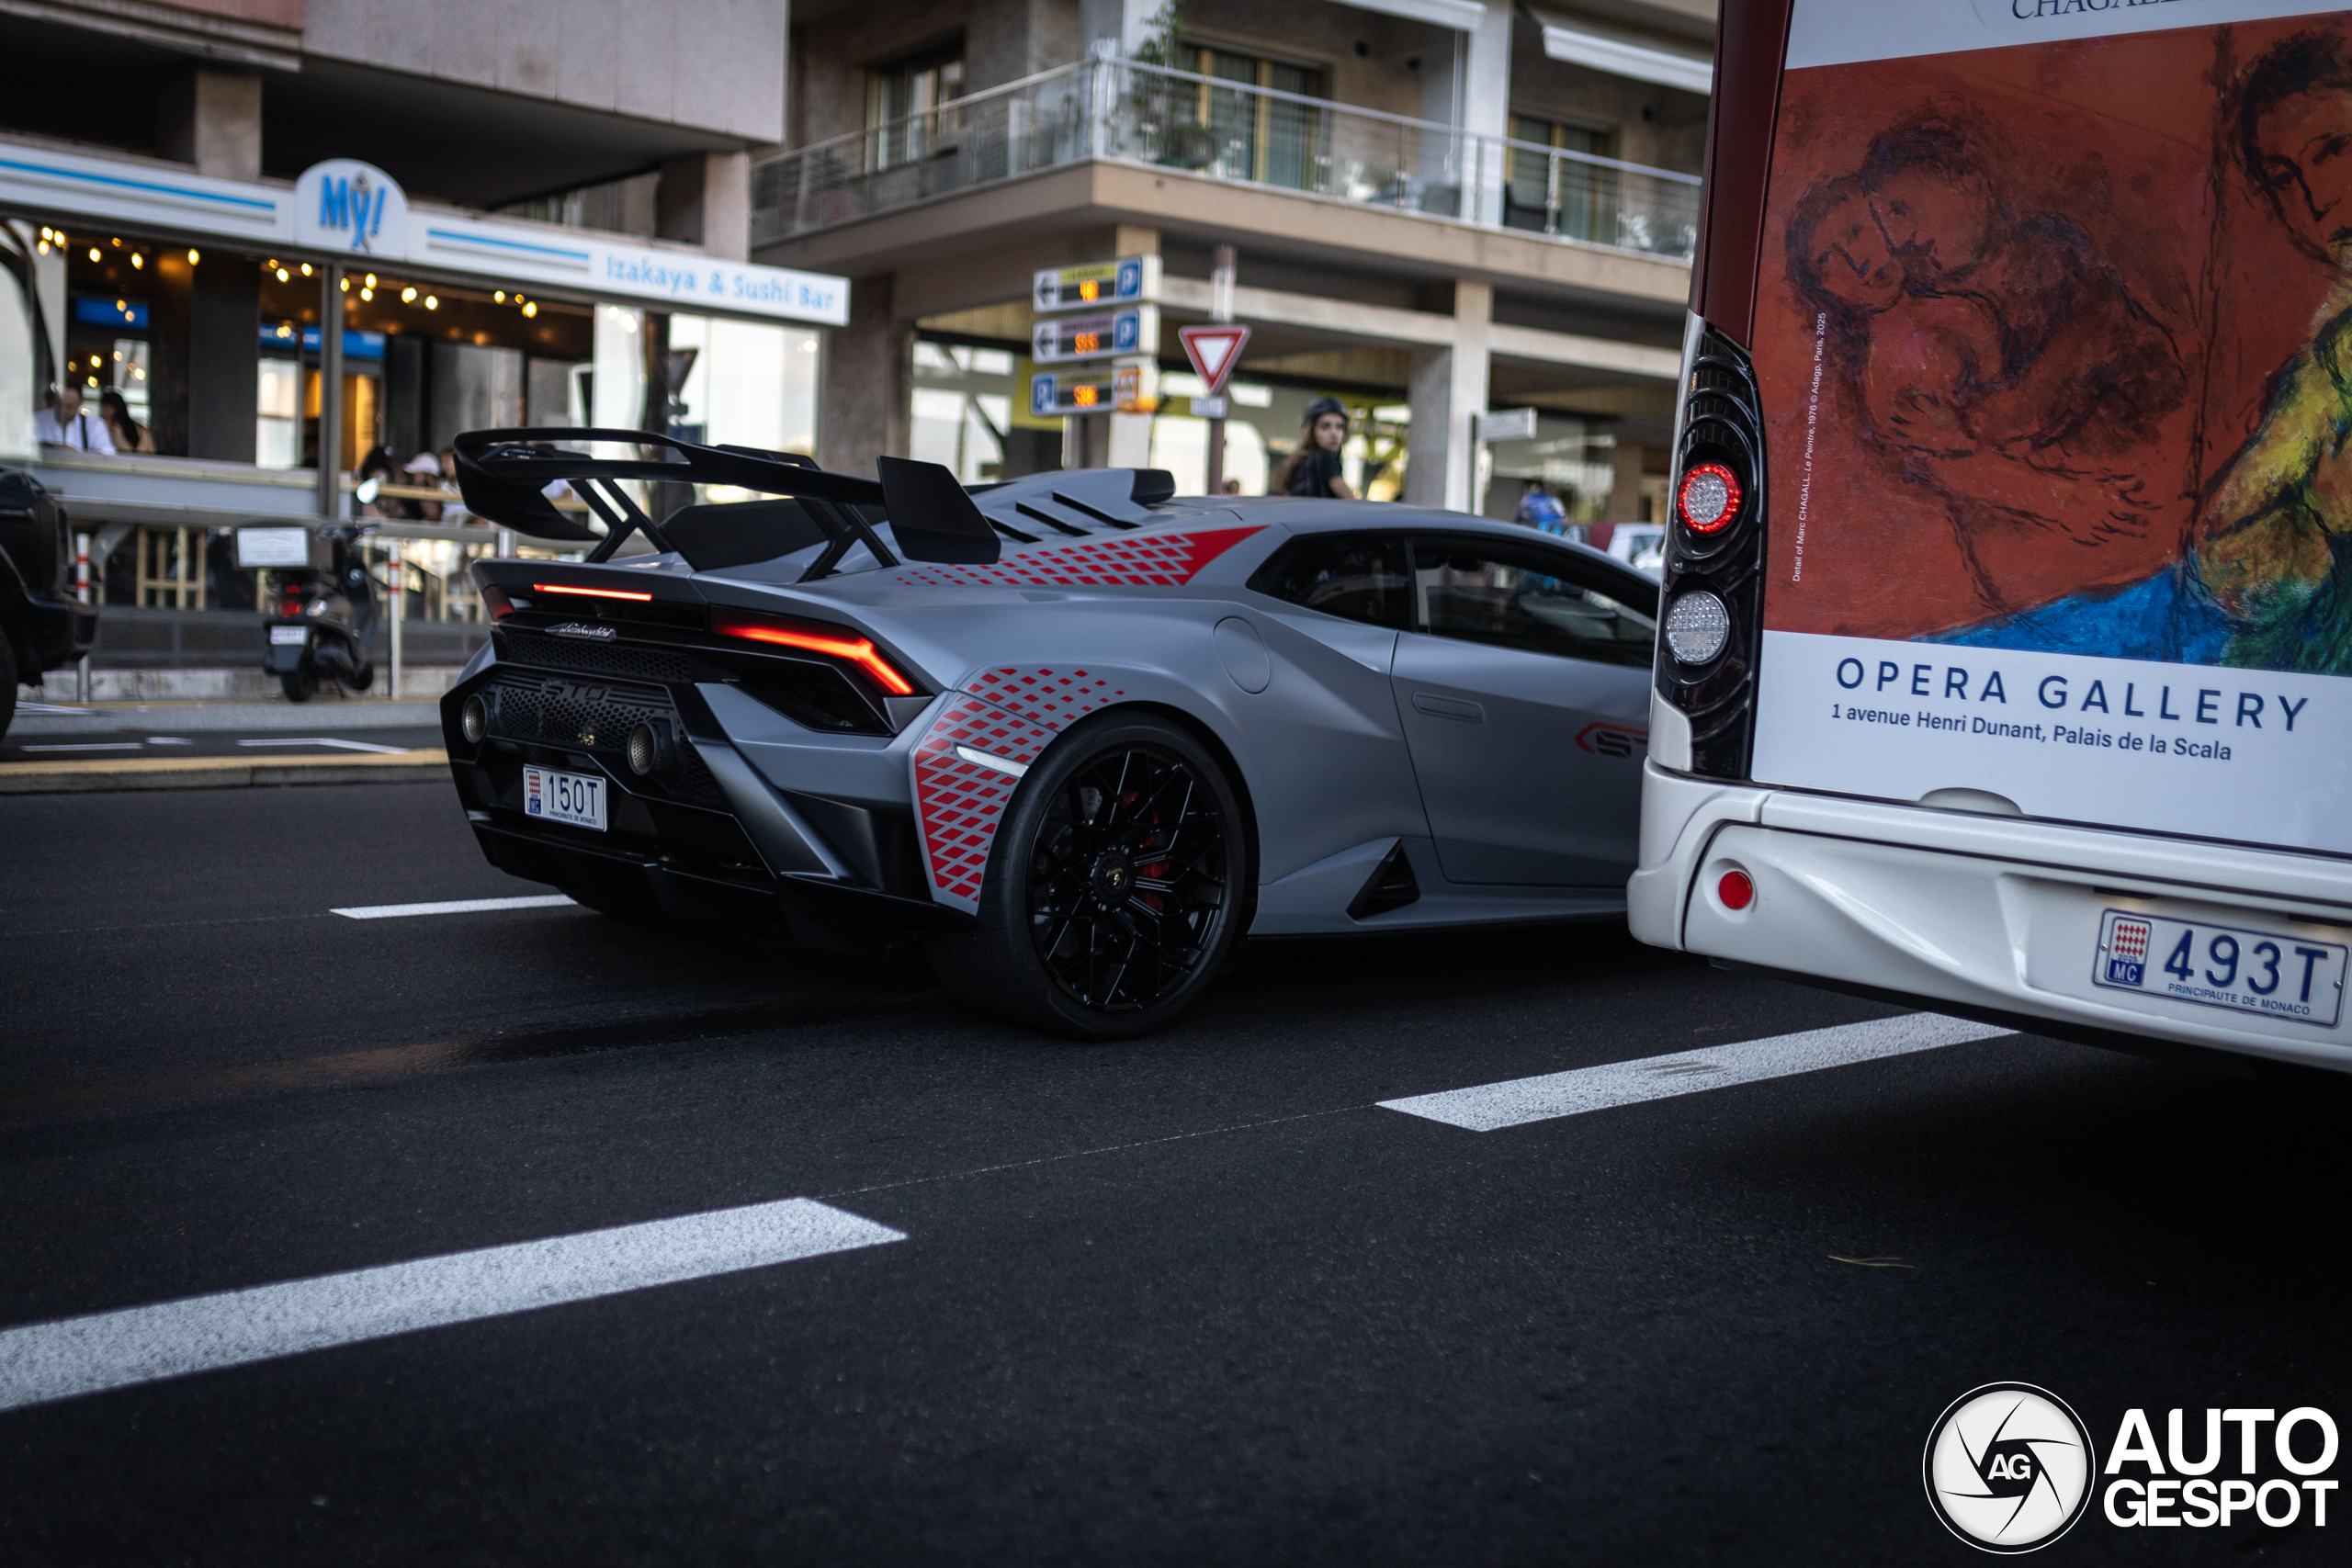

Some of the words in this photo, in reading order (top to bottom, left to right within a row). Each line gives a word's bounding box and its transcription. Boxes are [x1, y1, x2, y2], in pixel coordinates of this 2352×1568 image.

[607, 256, 695, 294] Izakaya
[709, 271, 725, 296] &
[734, 274, 790, 304] Sushi
[799, 286, 834, 310] Bar
[1816, 312, 1826, 336] 2025
[1814, 336, 1825, 362] Paris,
[1811, 363, 1823, 394] Adagp,
[1808, 404, 1817, 425] 1976
[1804, 426, 1816, 460] Peintre,
[1804, 461, 1812, 472] Le
[1796, 522, 1806, 545] Marc
[1795, 546, 1804, 556] of
[1792, 556, 1803, 582] Detail
[1836, 658, 2007, 704] OPERA
[2038, 675, 2309, 732] GALLERY
[1831, 704, 1841, 719] 1
[1847, 706, 1911, 726] avenue
[1917, 711, 1967, 732] Henri
[1972, 716, 2047, 743] Dunant,
[2053, 725, 2113, 748] Palais
[2118, 731, 2143, 751] de
[2150, 734, 2166, 753] la
[2173, 738, 2233, 761] Scala
[529, 798, 540, 813] MC
[548, 775, 598, 818] 150T
[549, 810, 573, 821] PRINCIPAUTE
[2117, 953, 2139, 964] 2025
[2164, 929, 2330, 1003] 493T
[2113, 963, 2139, 983] MC
[2168, 982, 2239, 1004] PRINCIPAUTE
[2242, 996, 2257, 1007] DE
[2260, 998, 2312, 1017] MONACO
